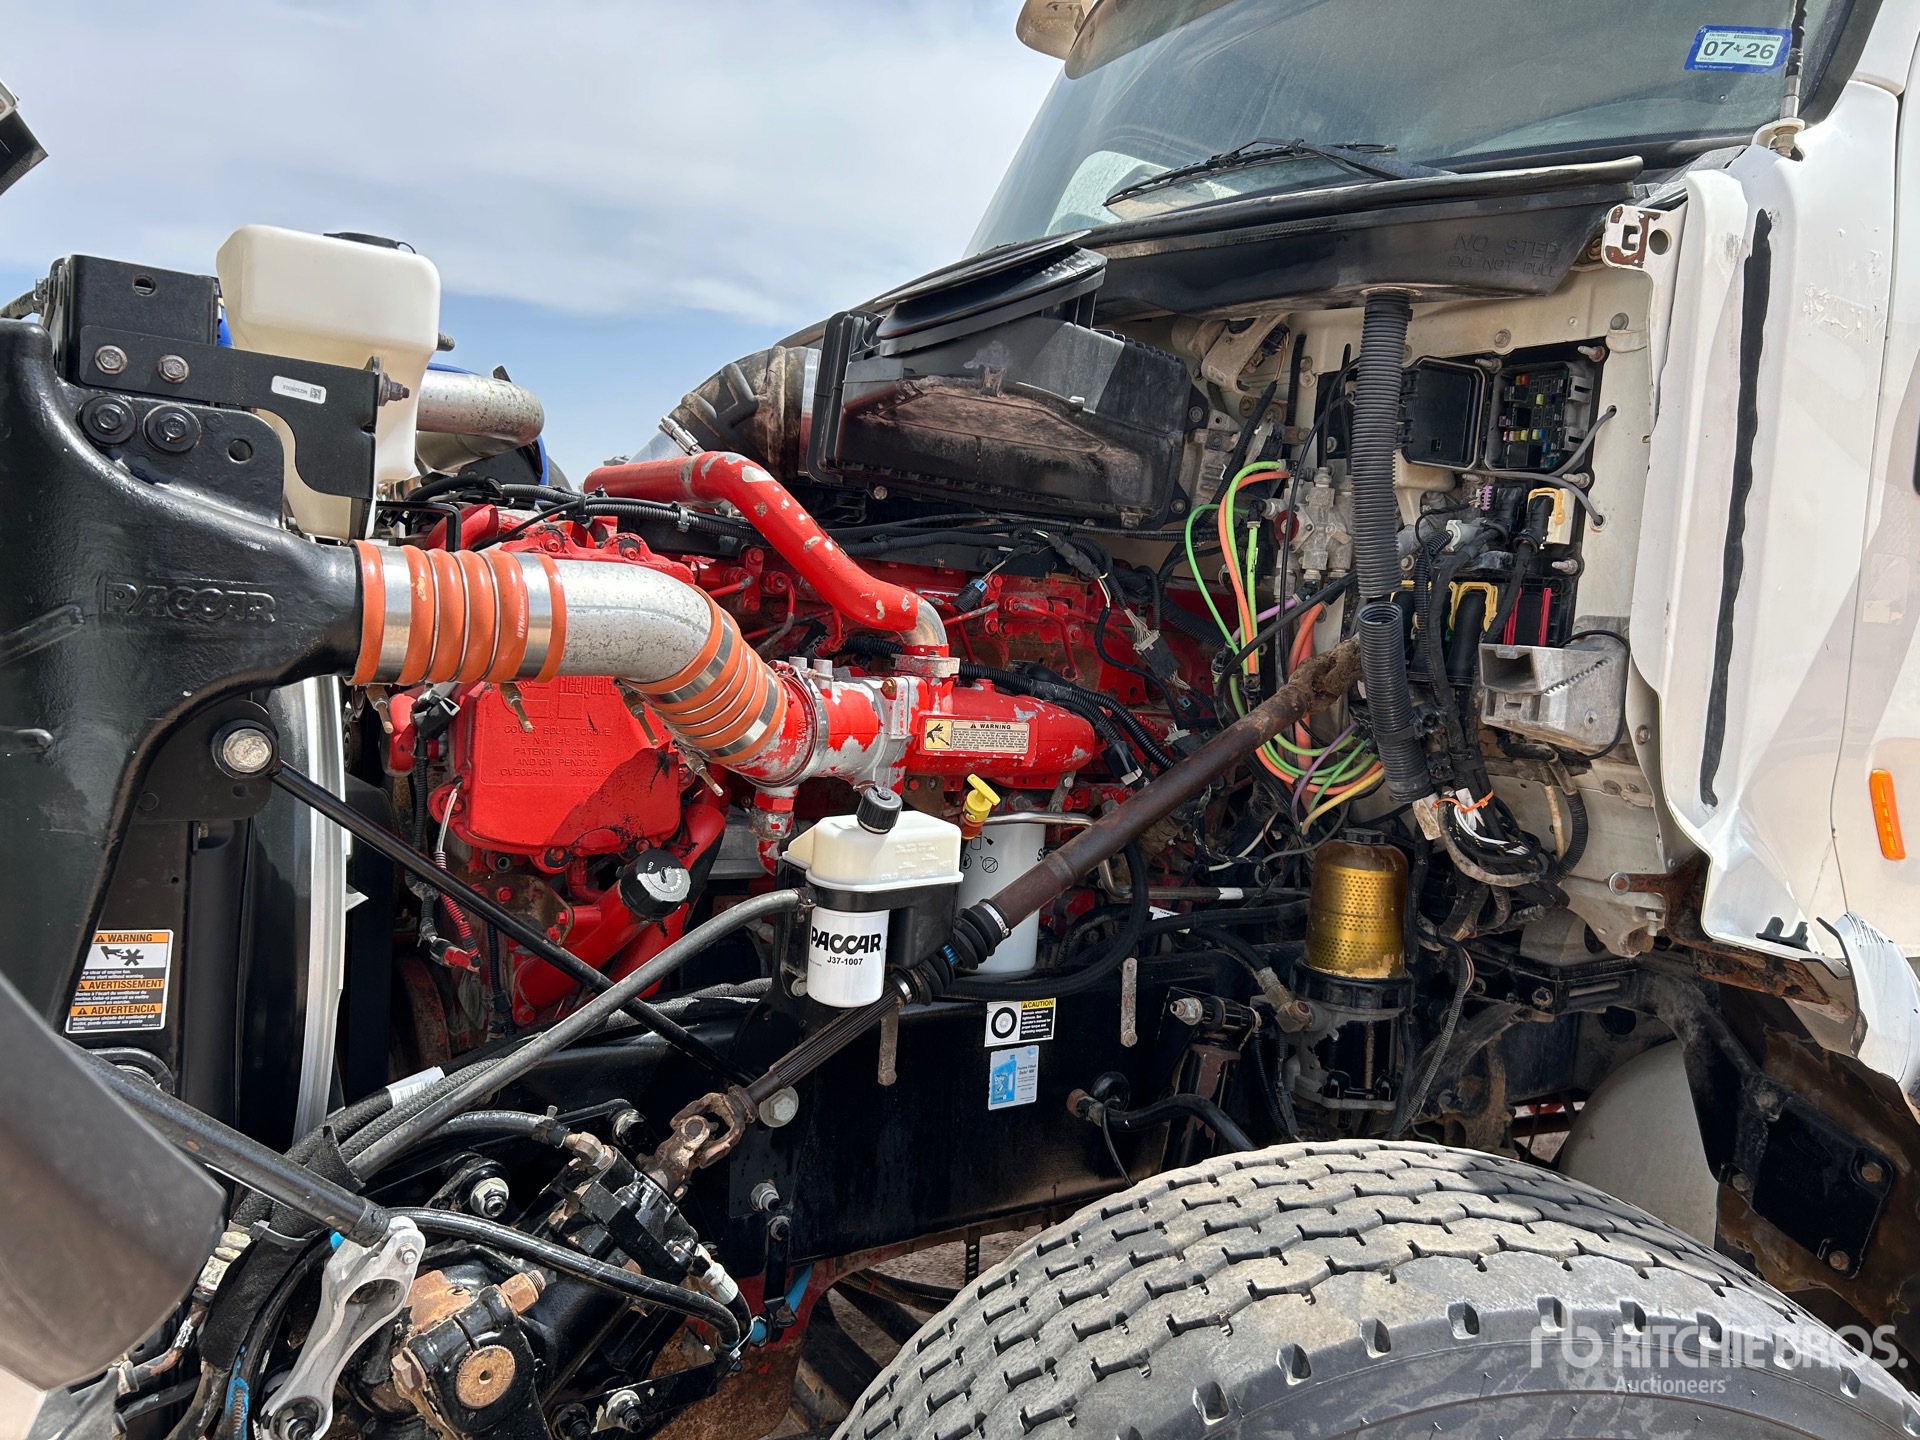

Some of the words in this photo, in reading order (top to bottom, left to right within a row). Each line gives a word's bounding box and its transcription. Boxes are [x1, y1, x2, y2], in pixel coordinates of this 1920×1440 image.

[1703, 41, 1735, 56] 07
[1743, 43, 1775, 60] 26
[1454, 233, 1488, 252] NO
[1504, 239, 1559, 259] STEP
[1448, 255, 1472, 267] DO
[1482, 258, 1514, 271] NOT
[1523, 262, 1556, 278] PULL
[104, 582, 276, 623] PACCAR
[504, 725, 536, 735] COVR
[108, 934, 153, 942] WARNING
[810, 925, 881, 955] PACCAR
[827, 956, 863, 966] J37-1007
[88, 980, 163, 989] AVERTISSEMENT
[1028, 1000, 1053, 1008] CAUTION
[91, 1005, 156, 1014] ADVERTENCIA
